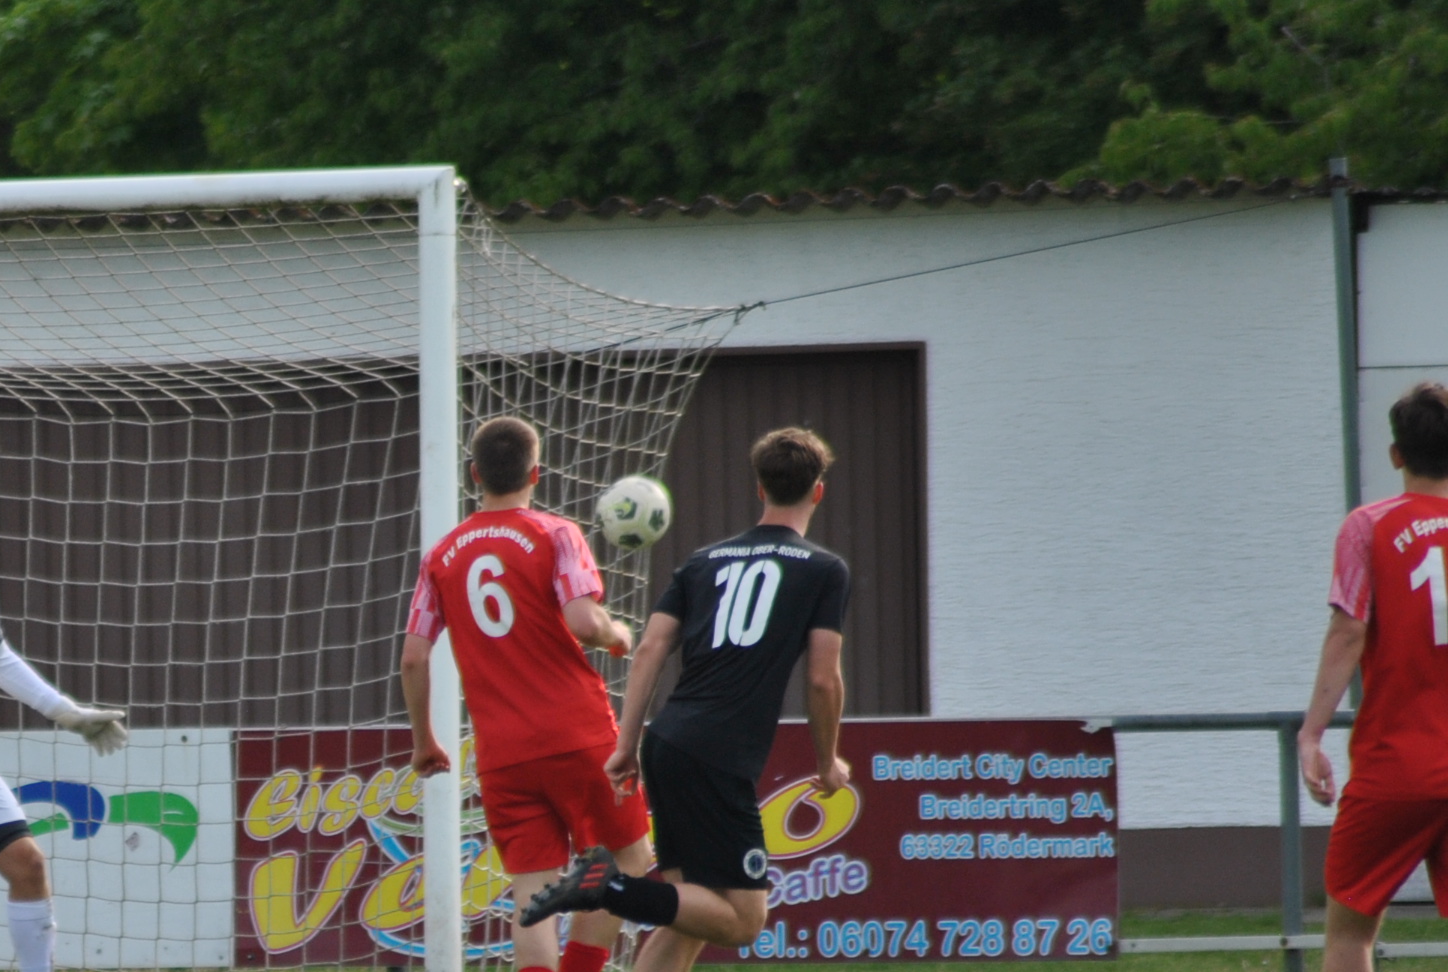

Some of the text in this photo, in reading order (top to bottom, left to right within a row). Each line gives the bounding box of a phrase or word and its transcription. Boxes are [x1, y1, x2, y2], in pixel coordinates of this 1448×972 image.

[442, 526, 535, 567] FV Eppertshausen
[708, 544, 811, 559] GERMANIA OBER-RODEN
[1393, 528, 1413, 553] FV
[467, 553, 515, 638] 6
[712, 559, 781, 649] 10
[1410, 546, 1448, 646] 1
[872, 752, 1114, 785] Breidert City Center
[919, 792, 1114, 824] Breidertring 2A,
[899, 832, 1115, 860] 63322 Rödermark
[767, 854, 868, 909] Caffe
[739, 918, 1113, 959] el.: 06074 728 87 26
